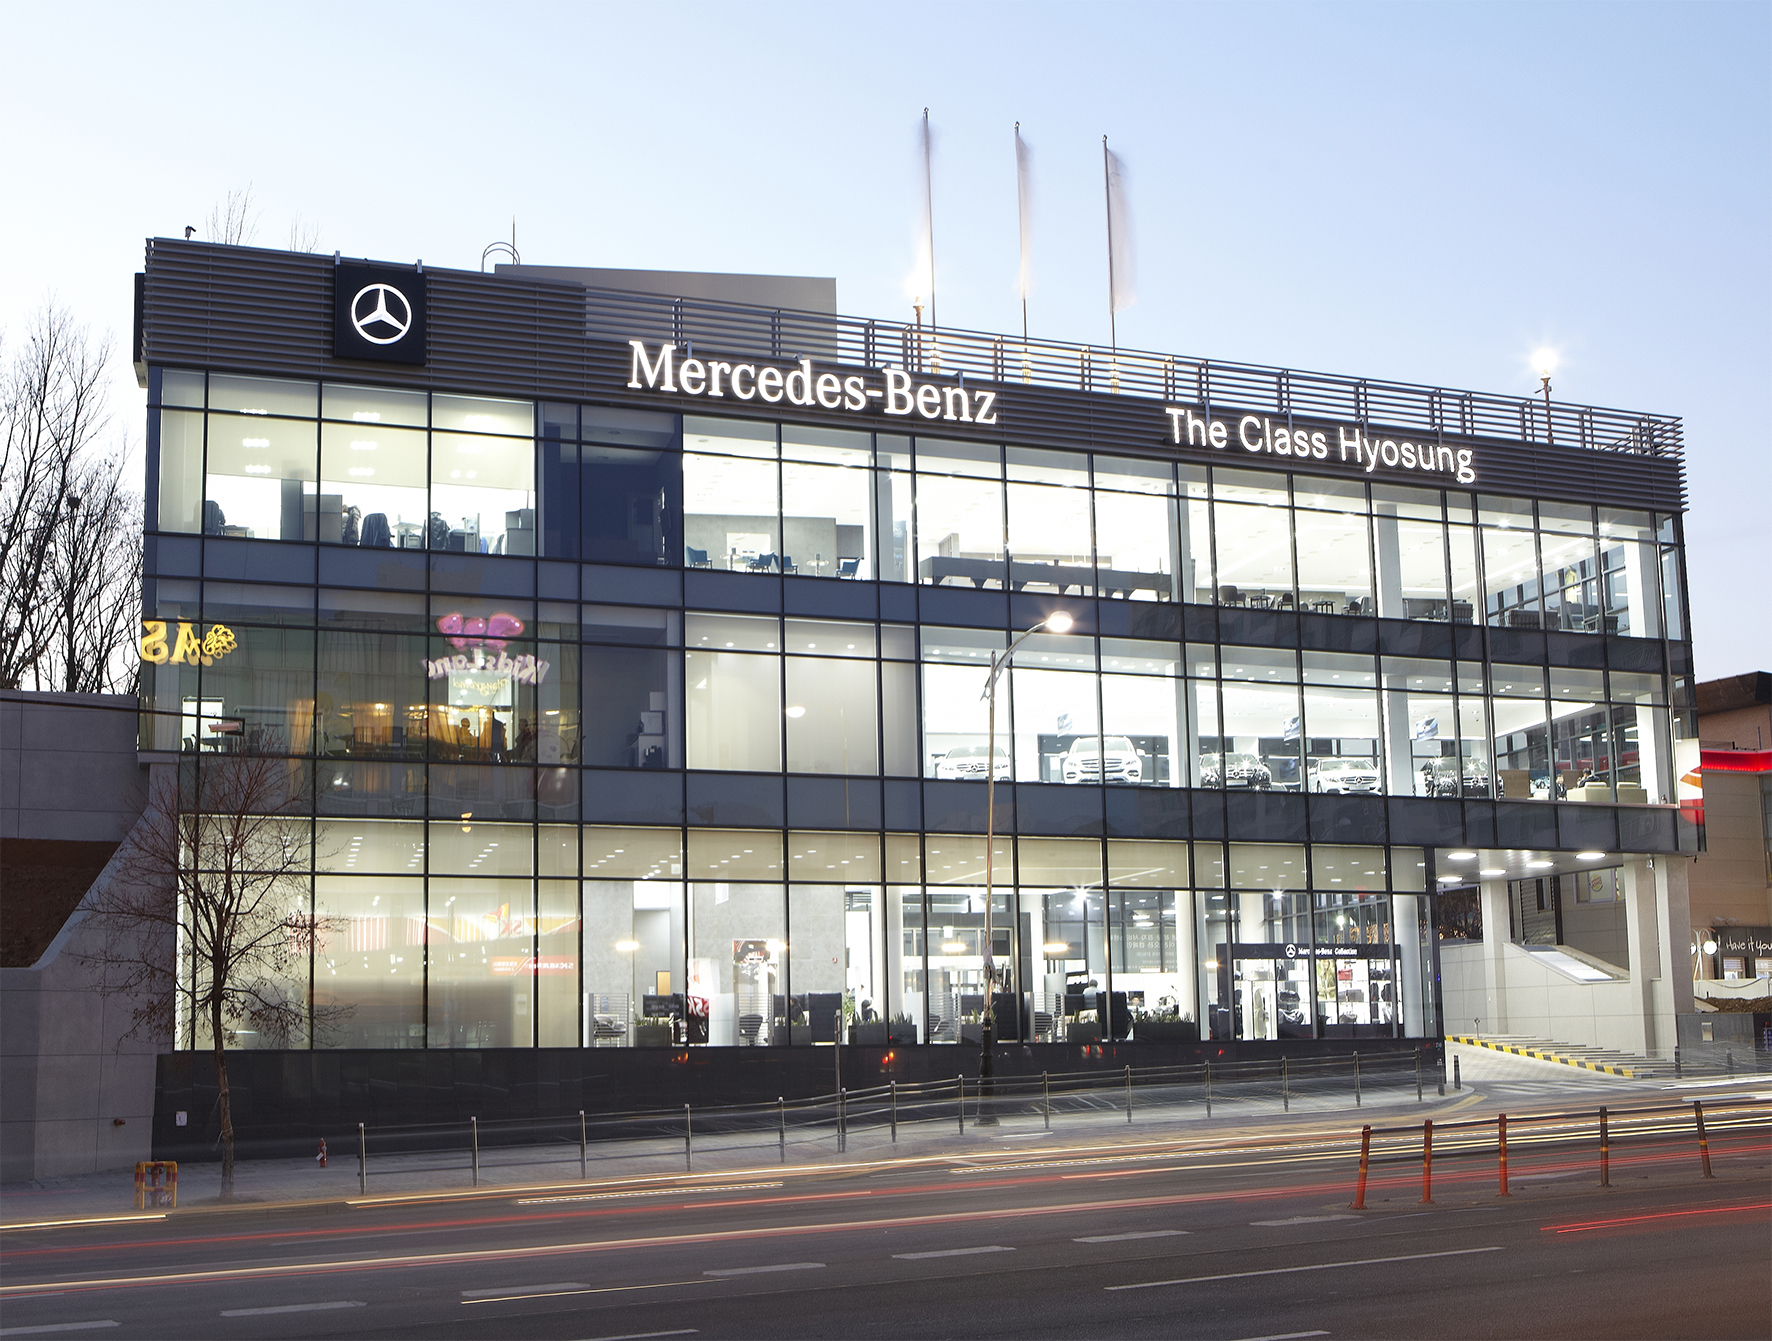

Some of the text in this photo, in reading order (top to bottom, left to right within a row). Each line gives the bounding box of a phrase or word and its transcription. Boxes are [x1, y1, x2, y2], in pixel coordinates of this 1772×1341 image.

[627, 340, 997, 425] Mercedes-Benz
[1165, 407, 1476, 484] The Class Hyosung
[1725, 936, 1746, 951] Have
[1747, 936, 1755, 952] it
